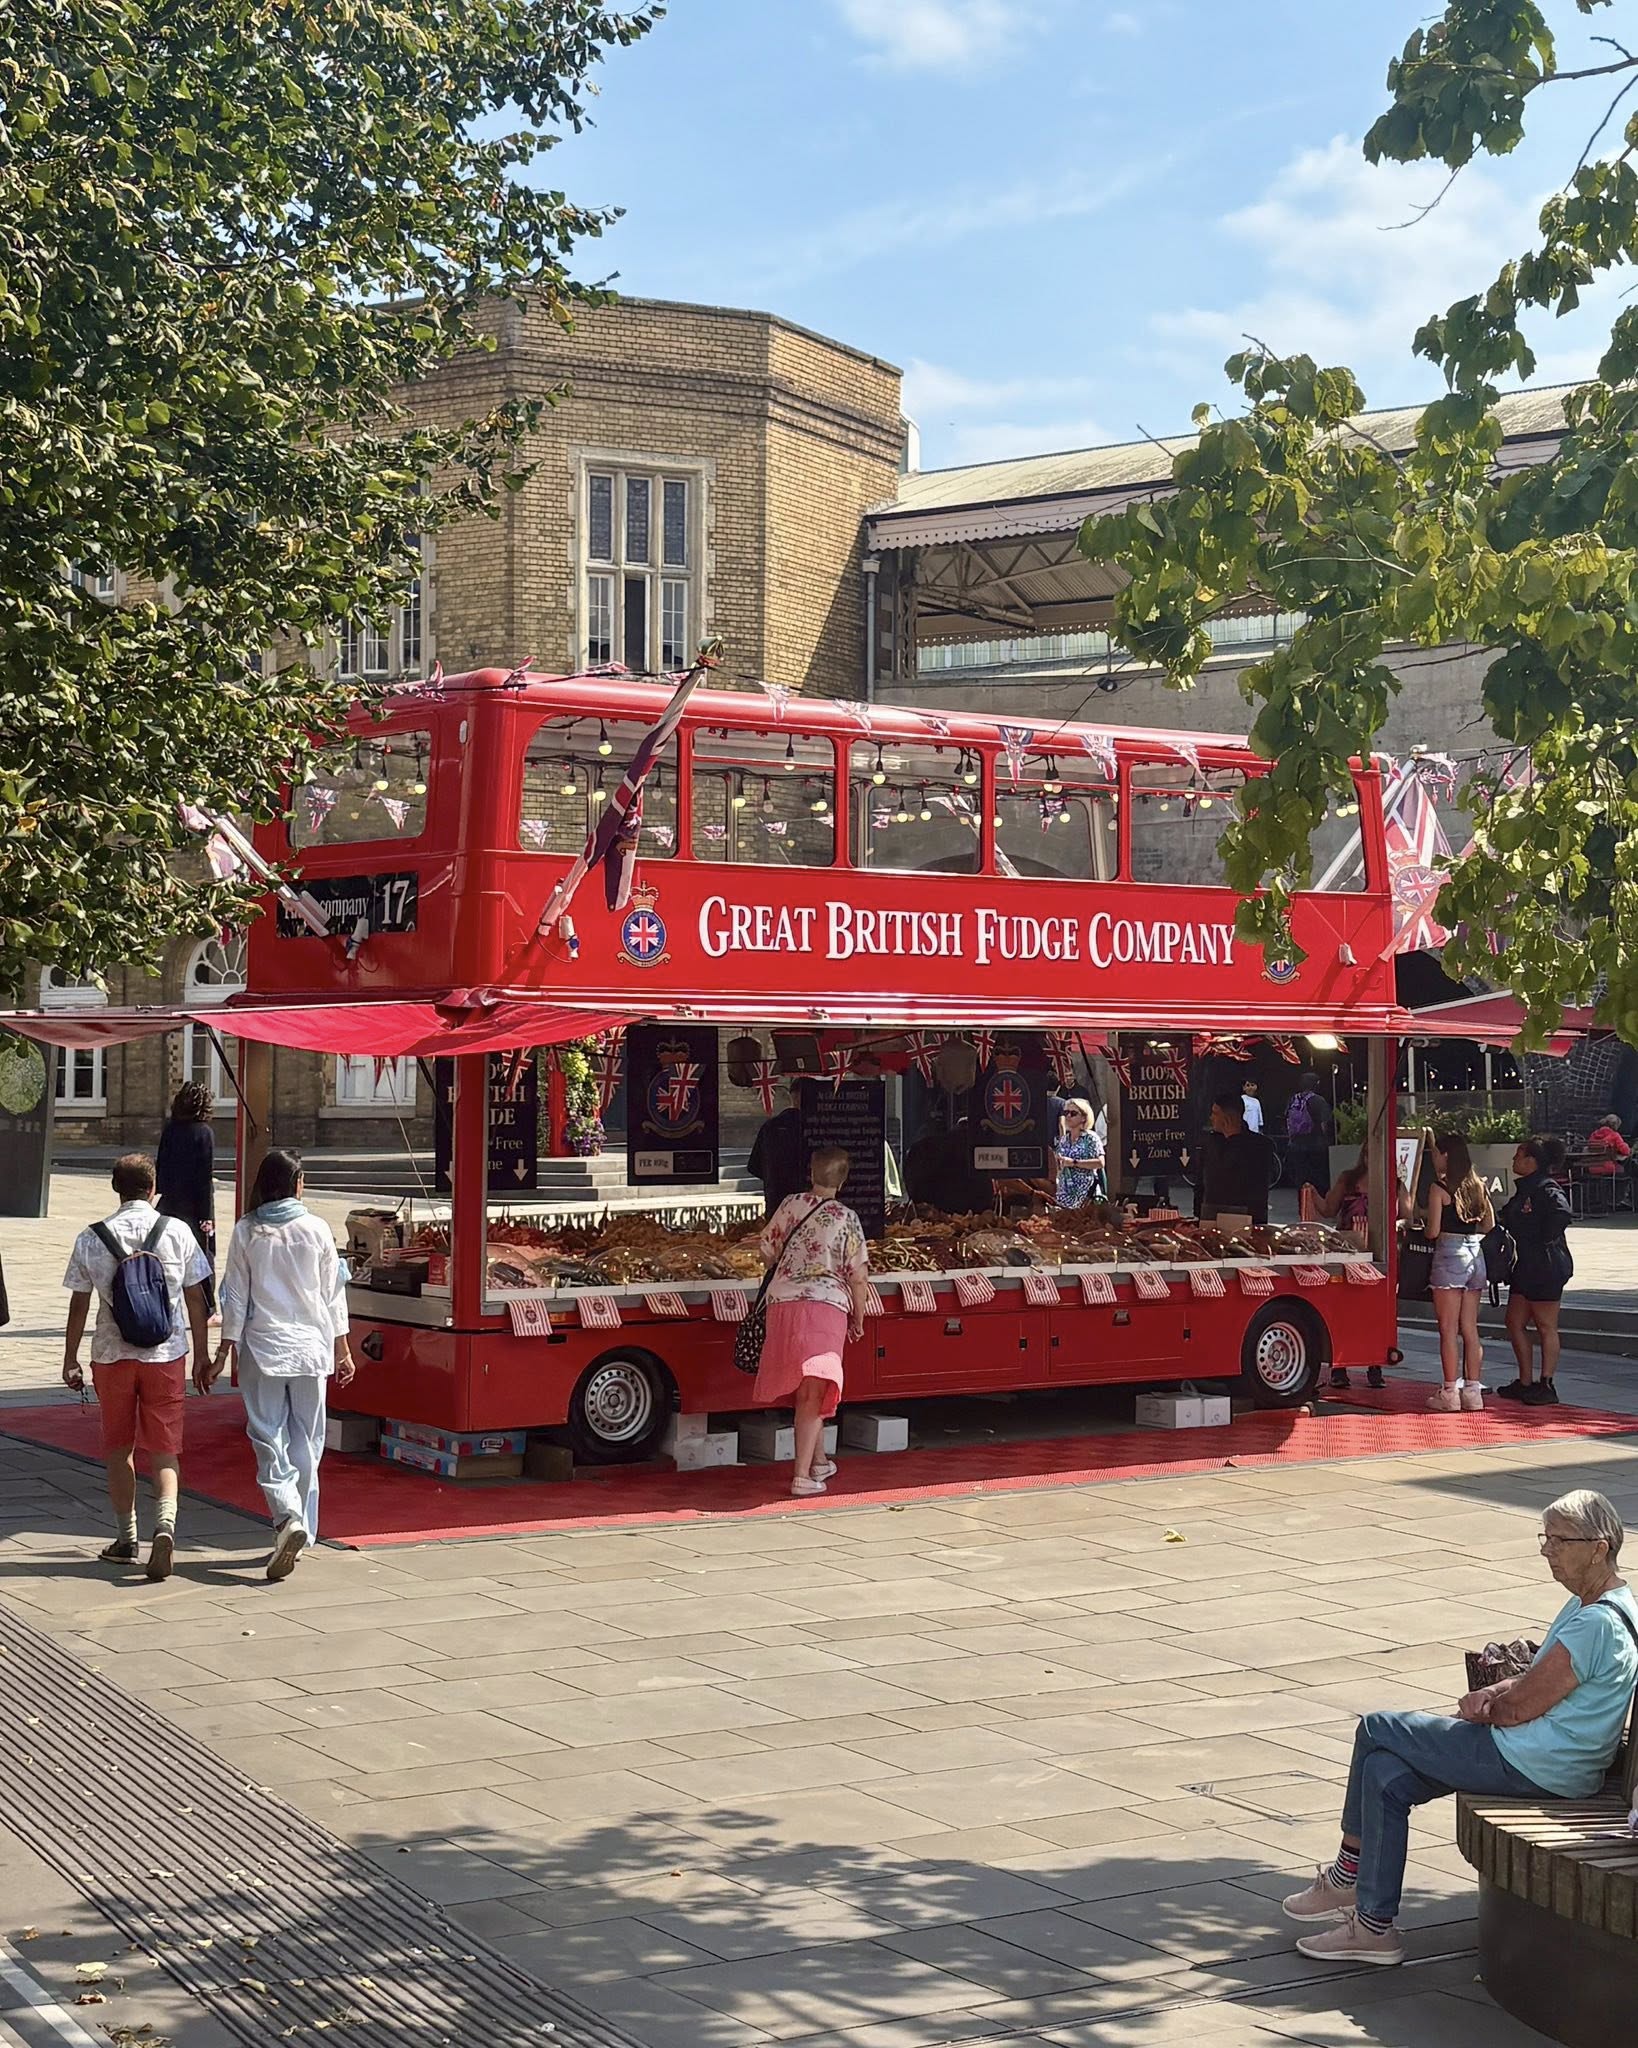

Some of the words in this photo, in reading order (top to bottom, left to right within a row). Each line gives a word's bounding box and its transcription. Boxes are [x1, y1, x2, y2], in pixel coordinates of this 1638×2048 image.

[381, 879, 411, 925] 17
[698, 895, 817, 958] GREAT
[825, 900, 964, 961] BRITISH
[974, 908, 1080, 966] FUDGE
[1088, 911, 1237, 969] COMPANY
[1128, 1084, 1186, 1101] BRITISH
[1136, 1104, 1180, 1121] MADE
[495, 1136, 524, 1150] Free
[1132, 1129, 1162, 1144] Finger
[1165, 1128, 1186, 1141] Free
[1147, 1146, 1173, 1159] Zone
